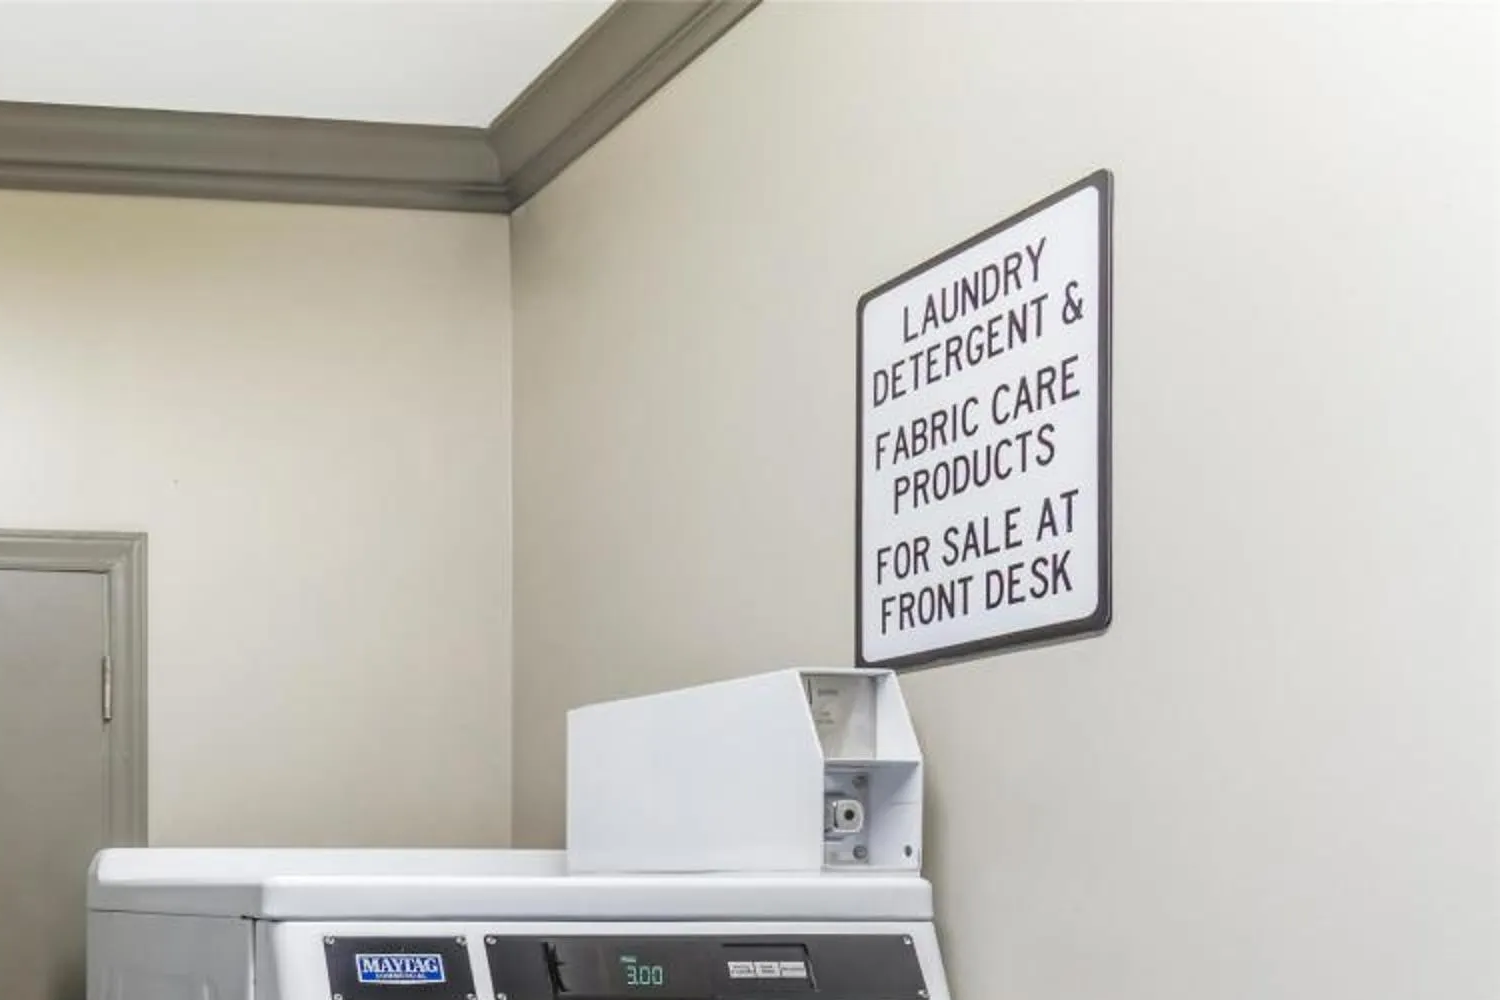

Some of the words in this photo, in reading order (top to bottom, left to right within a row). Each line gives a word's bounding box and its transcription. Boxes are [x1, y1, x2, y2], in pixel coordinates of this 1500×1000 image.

[903, 236, 1047, 344] LAUNDRY
[873, 294, 1049, 407] DETERGENT
[1061, 280, 1084, 325] &
[875, 397, 979, 471] FABRIC
[991, 355, 1081, 426] CARE
[893, 423, 1055, 515] PRODUCTS
[876, 536, 931, 585] FOR
[941, 507, 1023, 567] SALE
[1036, 489, 1079, 542] AT
[881, 575, 974, 635] FRONT
[985, 550, 1073, 611] DESK
[362, 957, 438, 972] MAYTAG
[627, 965, 663, 985] 3.00
